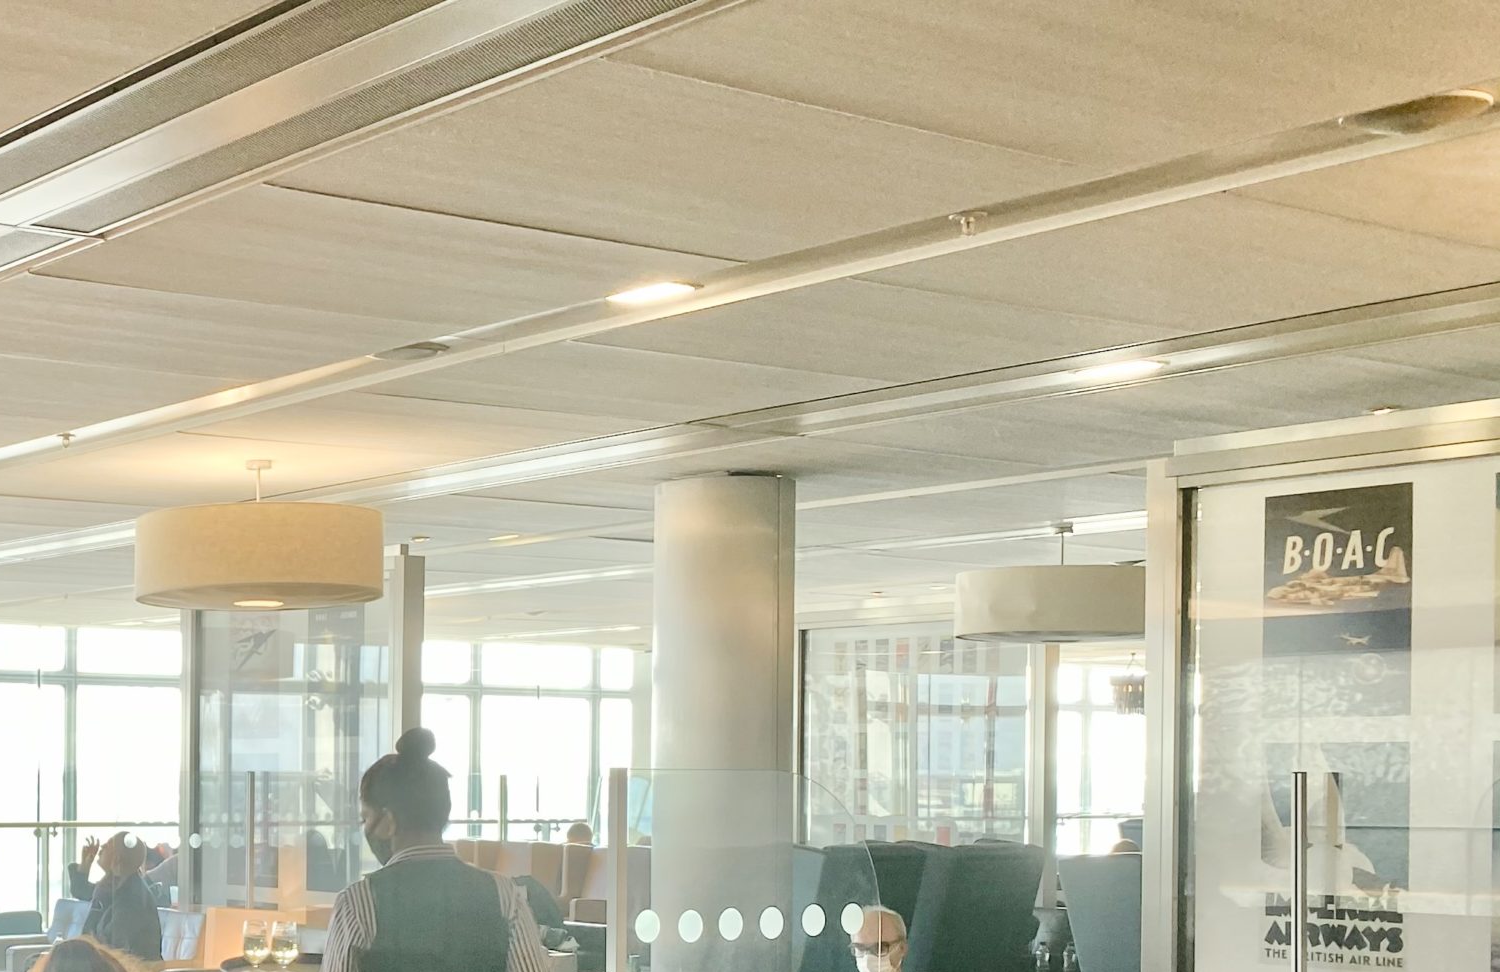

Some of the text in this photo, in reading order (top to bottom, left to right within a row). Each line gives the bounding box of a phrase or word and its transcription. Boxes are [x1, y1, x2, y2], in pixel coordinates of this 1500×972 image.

[1265, 947, 1404, 968] THE ITISH AIR LINE
